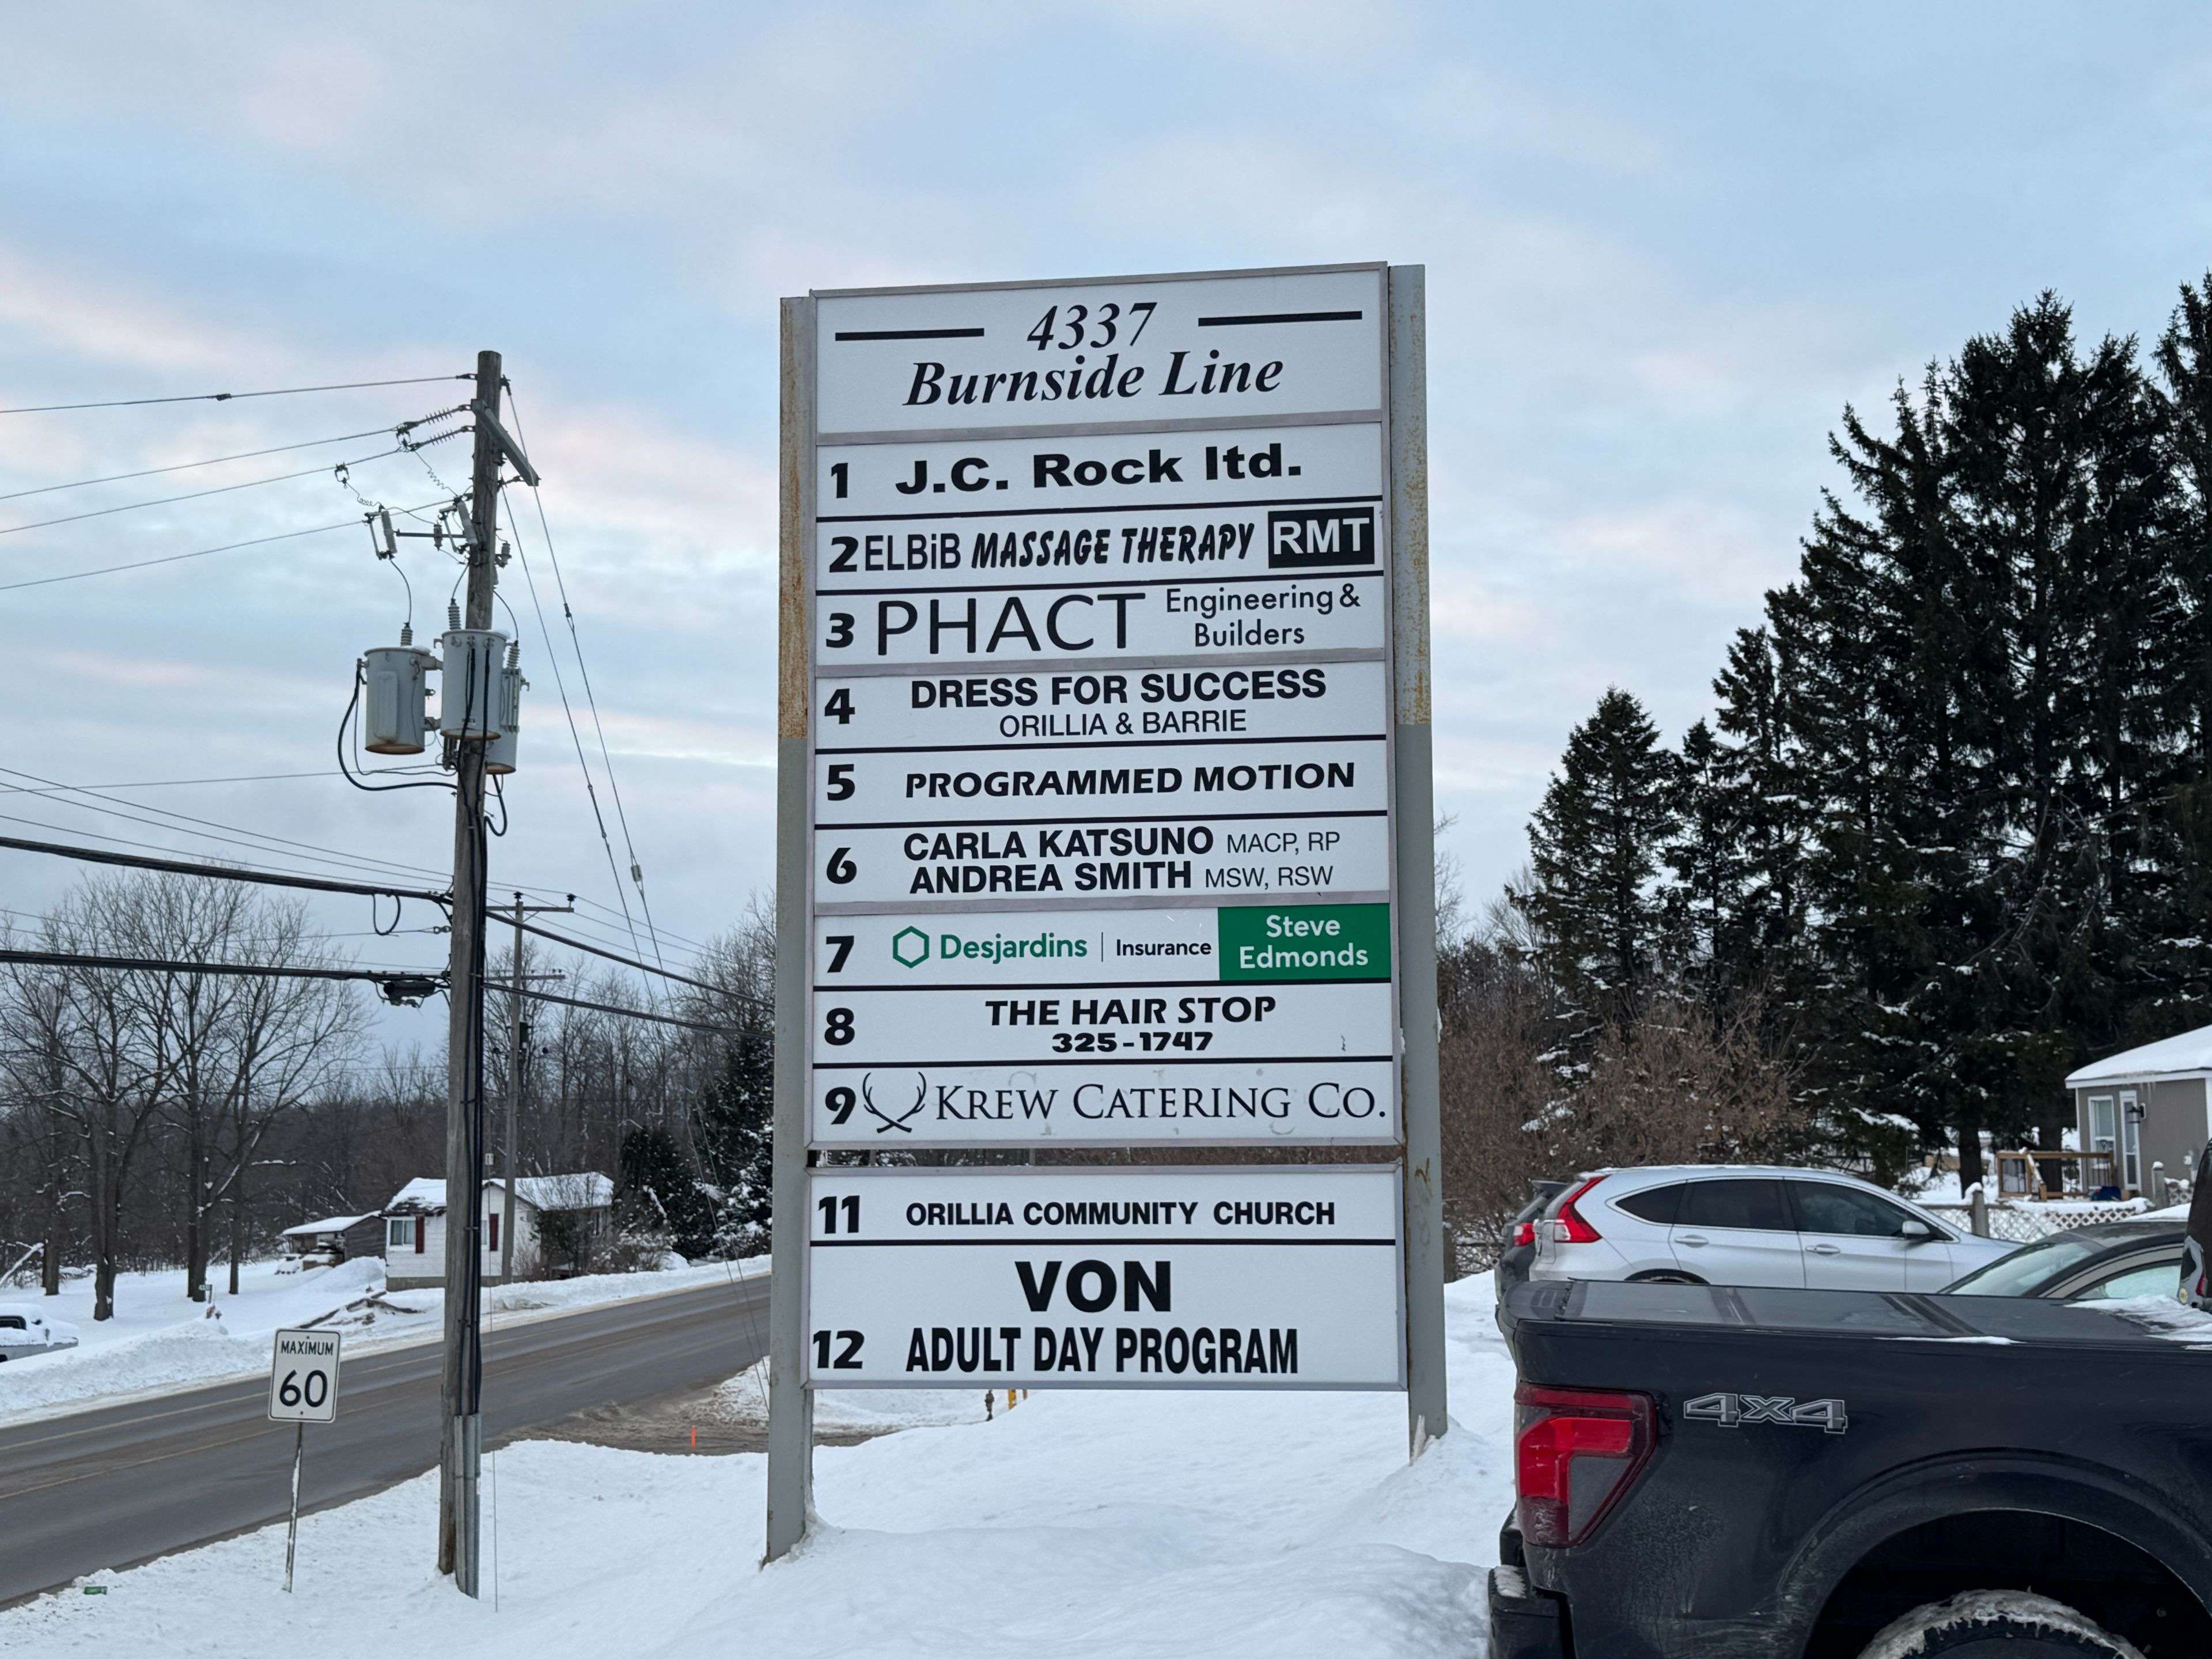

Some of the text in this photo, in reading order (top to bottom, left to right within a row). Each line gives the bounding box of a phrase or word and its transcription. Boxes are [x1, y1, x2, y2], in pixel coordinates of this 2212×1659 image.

[1027, 302, 1157, 350] 4337
[902, 350, 1283, 405] Burnside Line
[831, 443, 1301, 498] 1 J.C. Rock ltd.
[830, 518, 1369, 573] 2 ELBiB MASSAGE THERAPY RMT
[1167, 584, 1361, 620] Engineering &
[826, 590, 1145, 656] 3 PHACT
[1195, 619, 1304, 647] Builders
[825, 688, 855, 724] 4
[912, 669, 1325, 708] DRESS FOR SUCCESS
[1000, 710, 1246, 737] ORILLIA & BARRIE
[827, 763, 1354, 801] 5 PROGRAMMED MOTION
[904, 827, 1340, 861] CARLA KATSUNO MACP, RP
[827, 847, 857, 884] 6
[910, 861, 1333, 893] ANDREA SMITH MSW, RSW
[1267, 915, 1340, 937] Steve
[826, 933, 1087, 973] 7 Desjardins
[1117, 940, 1211, 956] Insurance
[1240, 943, 1368, 968] Edmonds
[824, 1008, 855, 1046] 8
[986, 997, 1275, 1025] THE HAIR STOP
[825, 1087, 855, 1124] 9
[819, 1195, 1334, 1234] 11 ORILLIA COMMUNITY CHURCH
[1015, 1260, 1171, 1313] VON
[281, 1341, 333, 1355] MAXIMUM
[813, 1327, 1297, 1374] 12 ADULT DAY PROGRAM
[279, 1370, 327, 1407] 60
